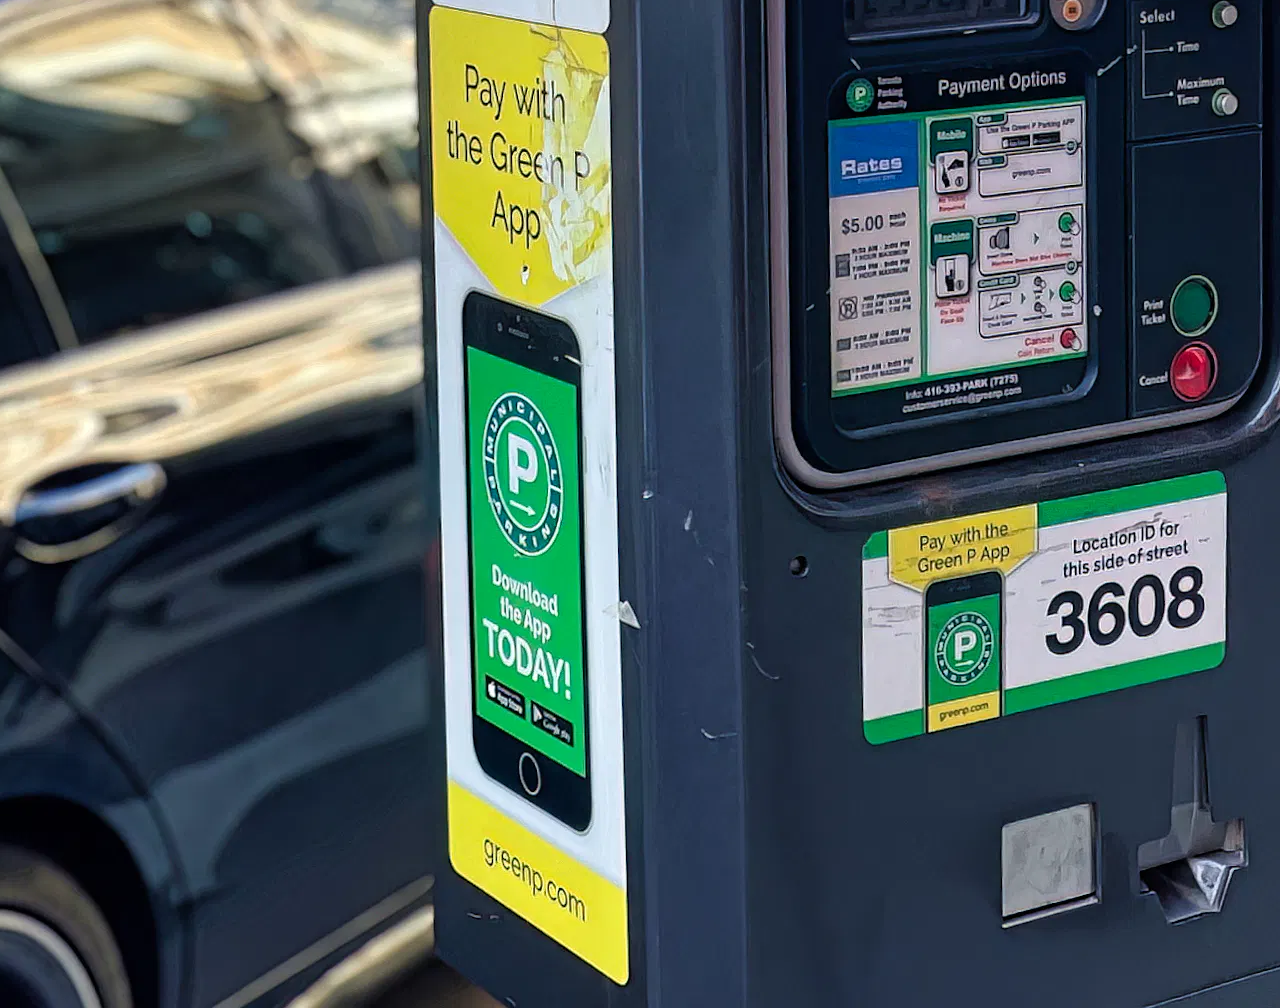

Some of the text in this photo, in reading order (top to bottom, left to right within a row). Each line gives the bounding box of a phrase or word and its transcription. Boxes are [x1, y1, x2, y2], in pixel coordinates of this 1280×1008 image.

[1140, 9, 1175, 24] Select
[1177, 41, 1200, 53] Time
[465, 64, 566, 124] Pay with
[938, 71, 1067, 98] Payment Options
[1177, 77, 1225, 91] Maximum
[1177, 94, 1200, 106] Time
[937, 130, 966, 141] Mobile
[1038, 119, 1061, 129] Parking
[447, 120, 590, 191] the Green P
[841, 157, 902, 175] Rates
[1012, 167, 1051, 179] greenp.com
[491, 190, 541, 249] App
[841, 214, 884, 235] $5.00
[934, 232, 970, 243] Machine
[1143, 300, 1163, 311] Print
[1141, 313, 1166, 325] Ticket
[1025, 333, 1055, 347] Cancel
[1018, 349, 1032, 358] Coin
[990, 373, 1019, 388] (7275)
[1139, 371, 1168, 386] Cancel
[486, 400, 557, 480] MUNICIPAL
[508, 432, 538, 494] P
[488, 476, 558, 548] PARKING
[920, 523, 1008, 552] Pay with the
[1073, 521, 1180, 554] Location ID for
[918, 545, 1009, 572] Green P App
[1063, 540, 1189, 578] this side of street
[492, 564, 558, 616] Download
[500, 596, 551, 643] the App
[1045, 566, 1205, 655] 3608
[954, 630, 977, 660] P
[482, 617, 571, 700] TODAY!
[939, 701, 989, 722] greenp.com
[484, 838, 586, 922] greenp.com
